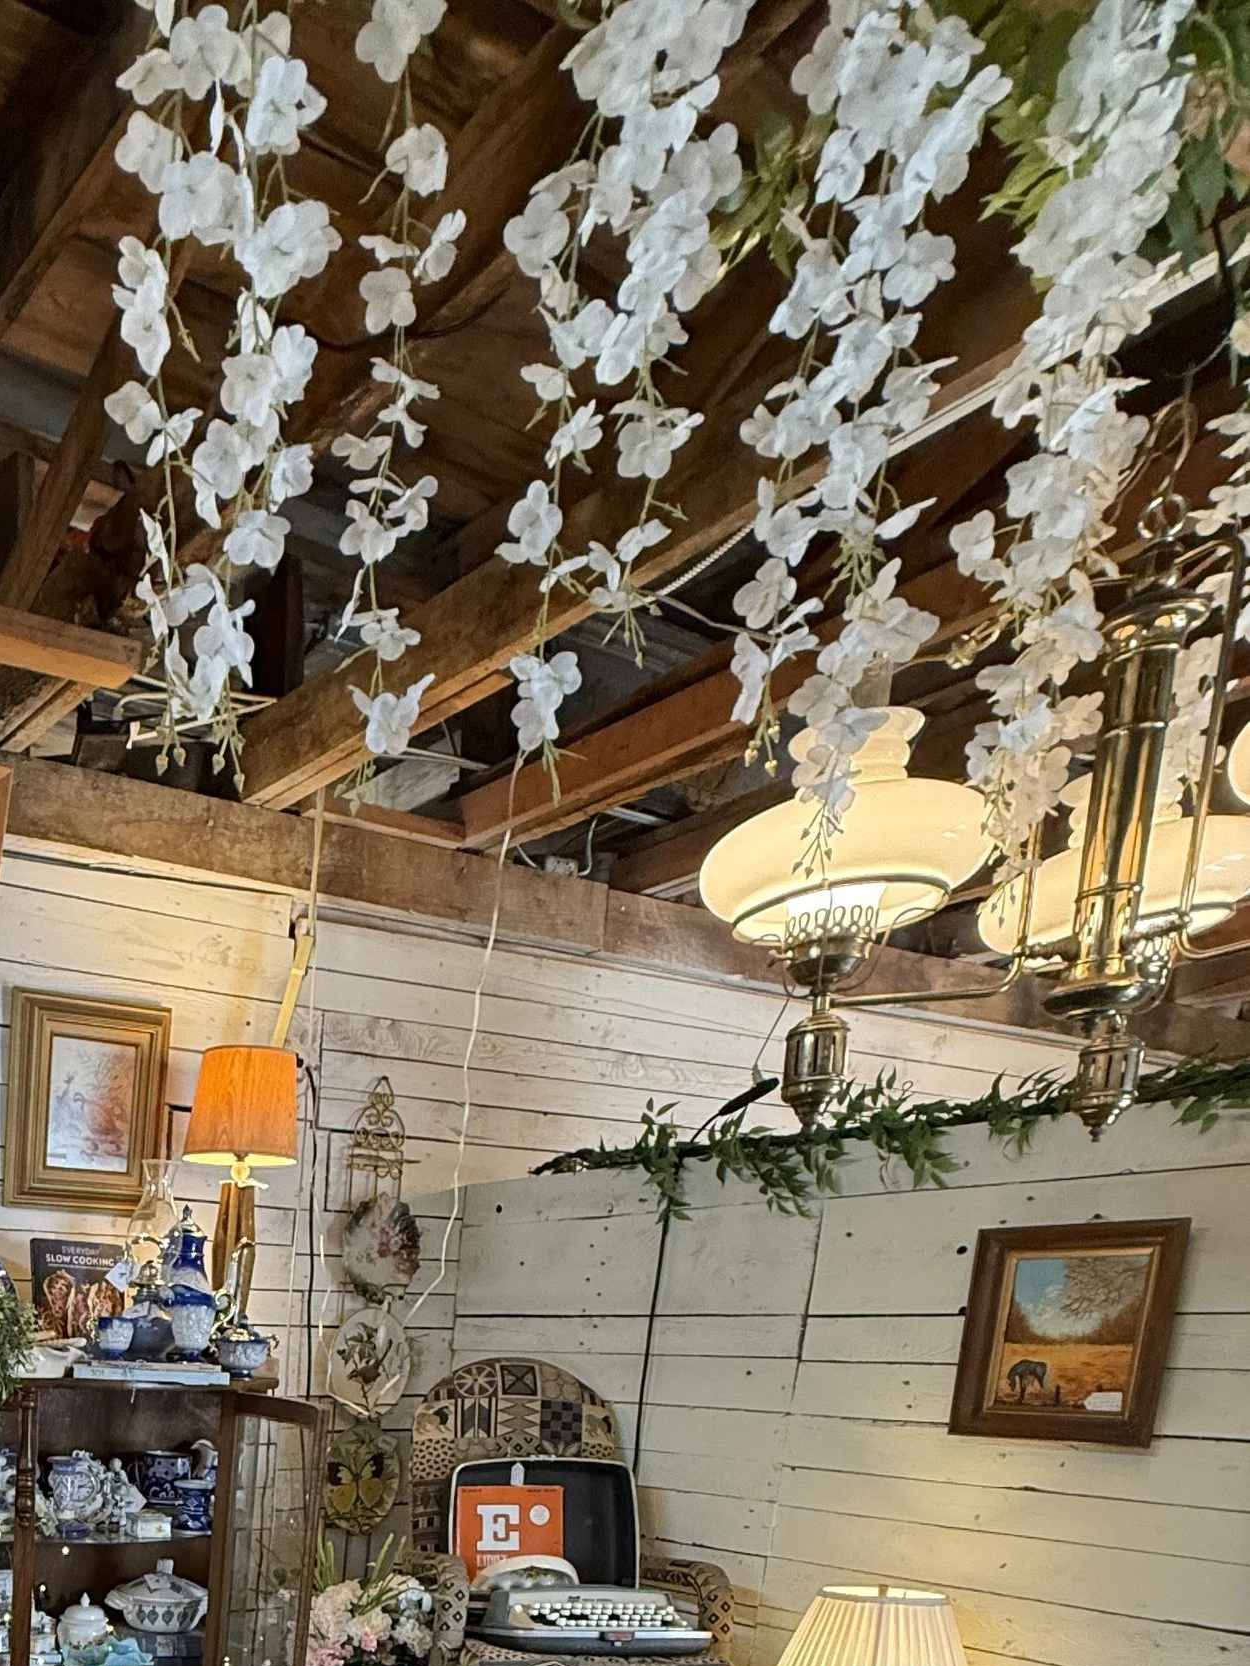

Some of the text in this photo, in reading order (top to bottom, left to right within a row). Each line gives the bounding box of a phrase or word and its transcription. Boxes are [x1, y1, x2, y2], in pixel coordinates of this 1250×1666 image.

[61, 1245, 102, 1256] EVERYDAY
[45, 1254, 115, 1267] SLOW COOKING
[477, 1504, 520, 1551] E
